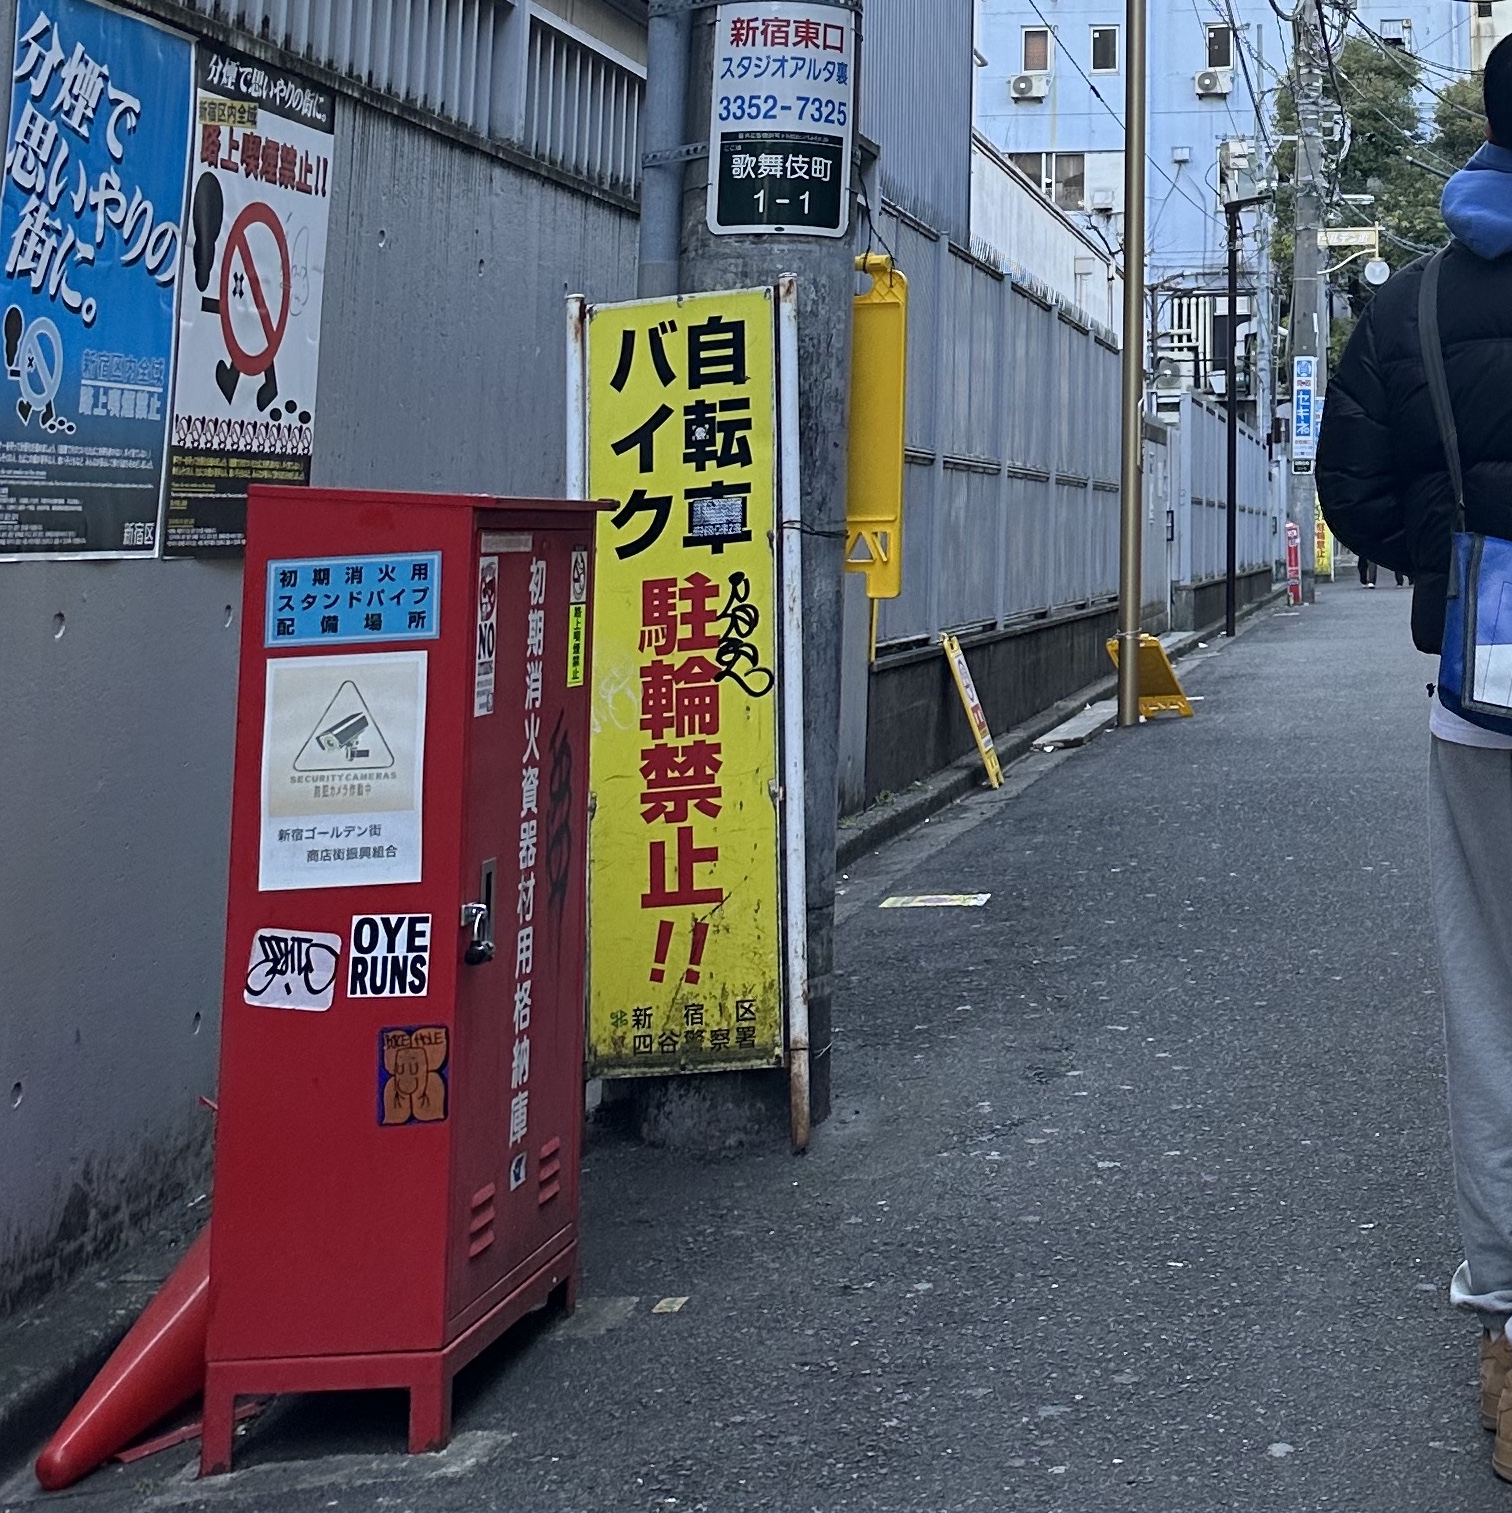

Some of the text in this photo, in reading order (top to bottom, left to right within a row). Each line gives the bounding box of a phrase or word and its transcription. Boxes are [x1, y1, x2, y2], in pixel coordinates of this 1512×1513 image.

[730, 17, 844, 54] 新宿東口
[14, 11, 141, 159] 分煙で
[721, 55, 849, 87] スタジオアルタ裏
[718, 95, 848, 127] 3352-7325
[731, 153, 833, 182] 歌舞伎町
[5, 100, 181, 283] 思いやりの
[753, 189, 810, 215] 1-1
[5, 194, 97, 324] 街に。
[610, 319, 679, 561] バイク
[683, 315, 752, 555] 自転車
[123, 522, 154, 545] 新宿区
[279, 562, 429, 589] 初期消火用
[276, 610, 428, 637] 配備場所
[478, 622, 495, 660] NO
[638, 571, 723, 985] 駐輪禁止!!
[278, 823, 382, 843] 新宿ゴールデン街
[353, 916, 430, 955] OYE
[350, 954, 427, 996] RUNS
[631, 999, 757, 1030] 新宿区
